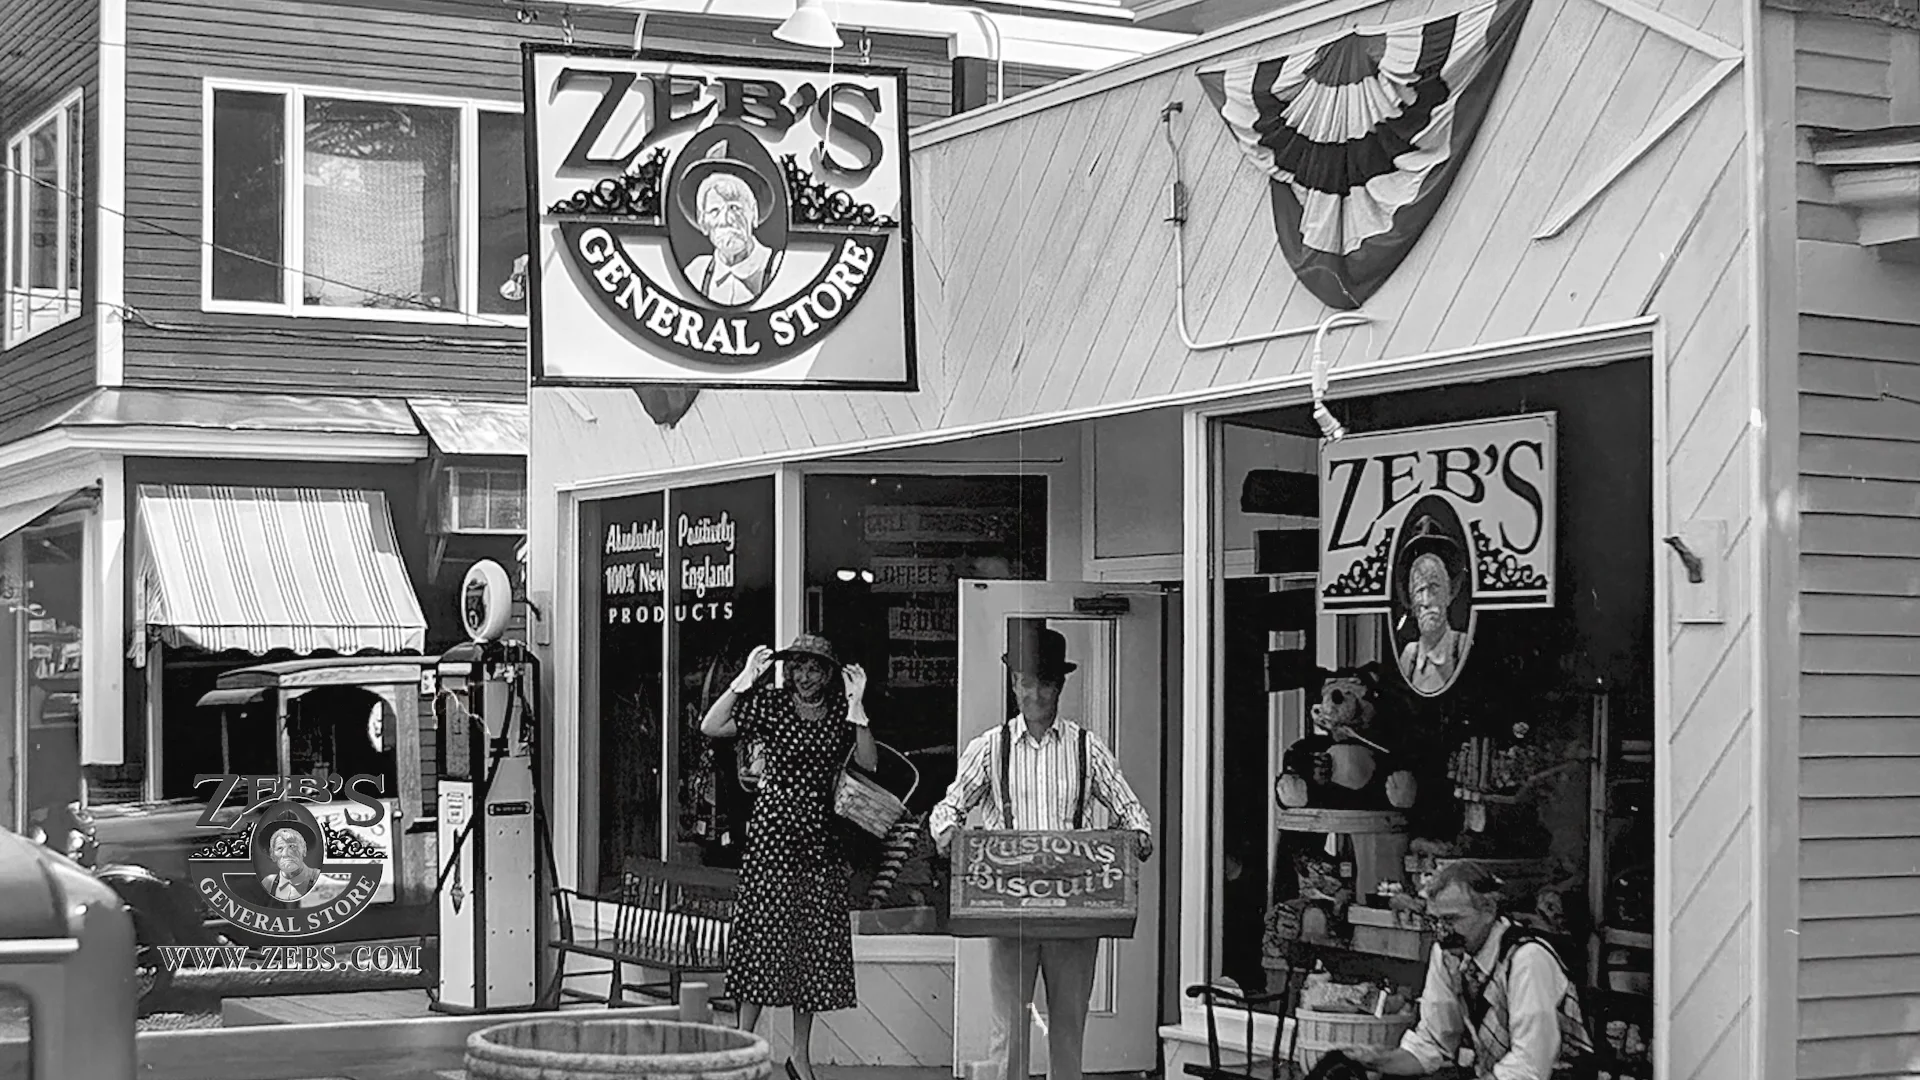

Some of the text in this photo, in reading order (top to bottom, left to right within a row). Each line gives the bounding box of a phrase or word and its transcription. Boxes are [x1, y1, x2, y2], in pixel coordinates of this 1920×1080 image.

[551, 67, 884, 180] ZEB'S
[578, 227, 874, 355] GENERAL STORE
[677, 511, 736, 552] Positively
[1328, 440, 1544, 555] ZEB'S
[605, 553, 735, 599] 100% New England
[608, 602, 734, 625] PRODUCTS
